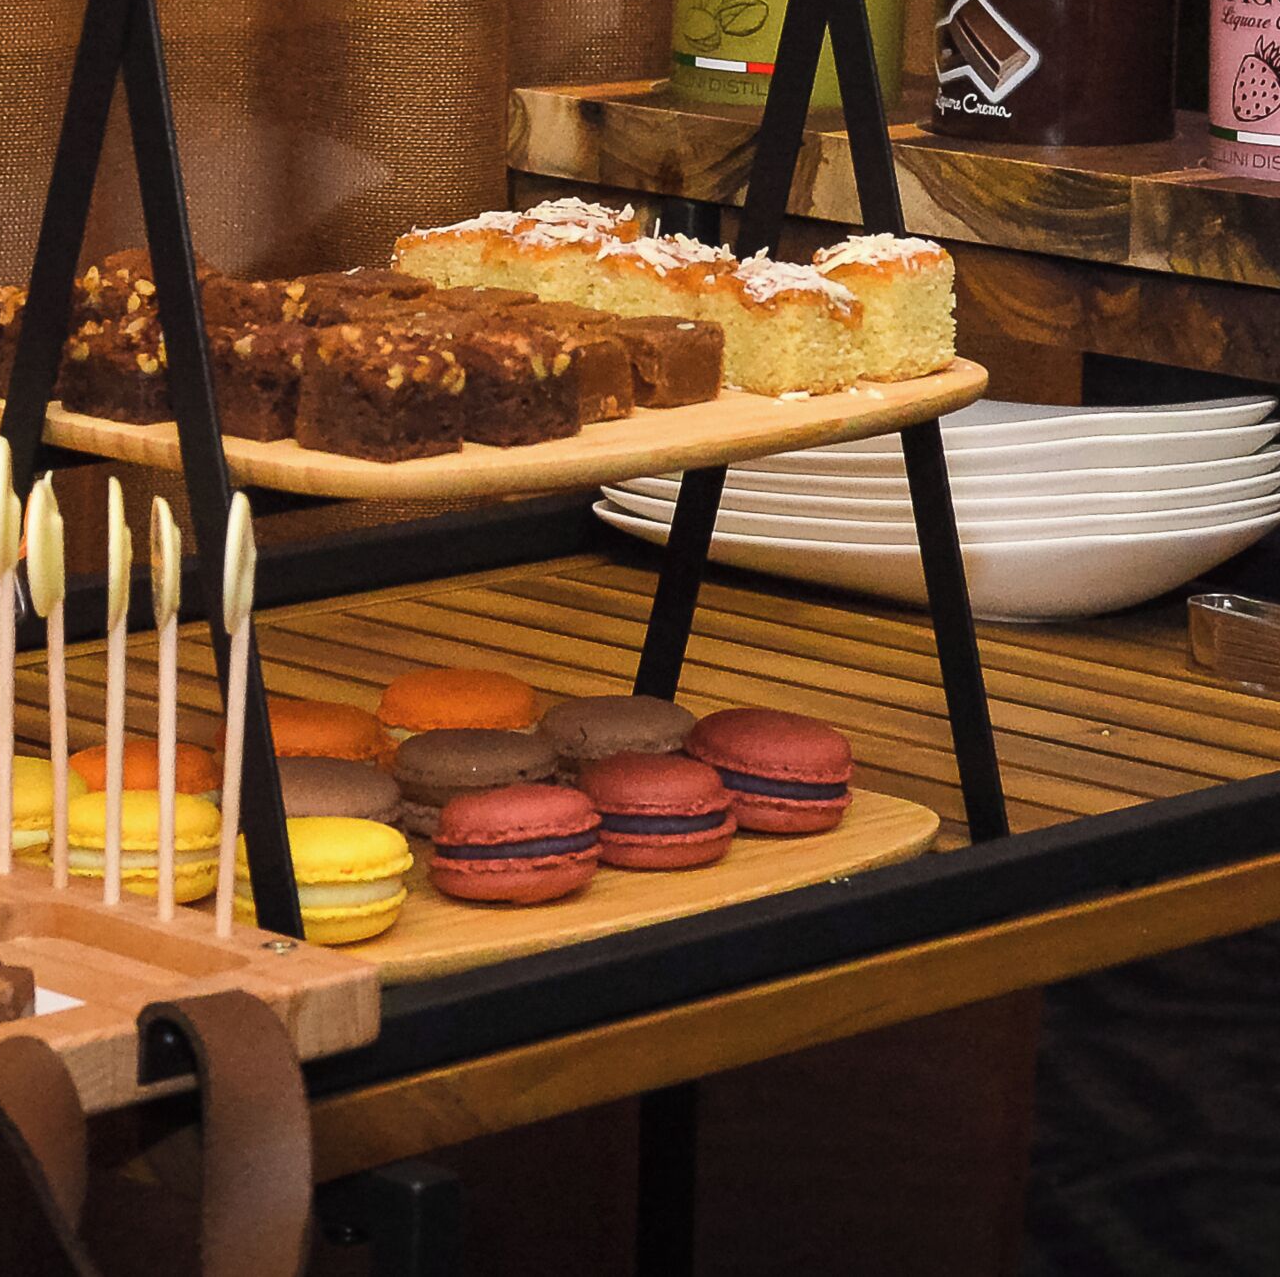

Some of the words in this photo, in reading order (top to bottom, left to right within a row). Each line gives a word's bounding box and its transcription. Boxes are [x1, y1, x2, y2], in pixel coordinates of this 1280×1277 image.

[1222, 5, 1271, 32] Liquore
[708, 78, 768, 97] DISTIL
[962, 93, 1013, 119] Crema
